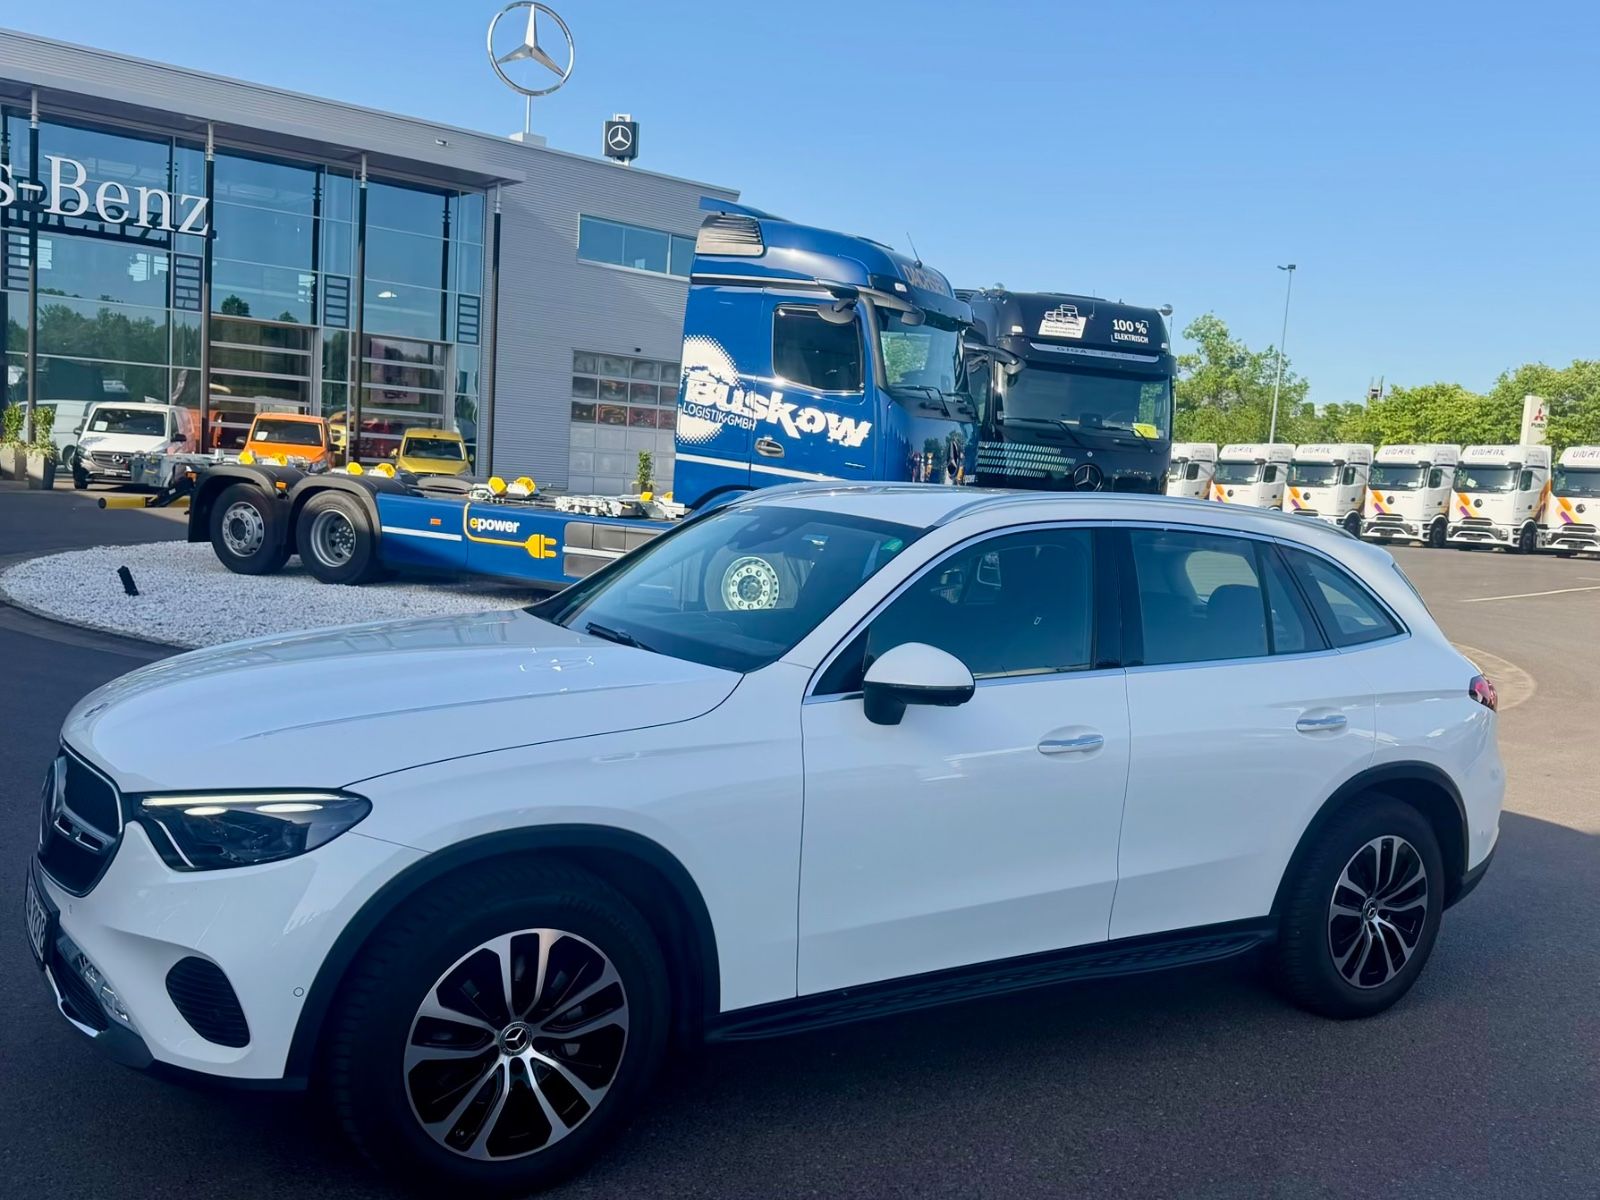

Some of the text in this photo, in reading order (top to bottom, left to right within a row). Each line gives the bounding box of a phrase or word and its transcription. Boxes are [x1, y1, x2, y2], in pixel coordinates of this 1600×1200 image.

[1112, 319, 1147, 334] 100 %
[1114, 333, 1149, 343] ELEKTRISCH
[470, 517, 520, 533] epower
